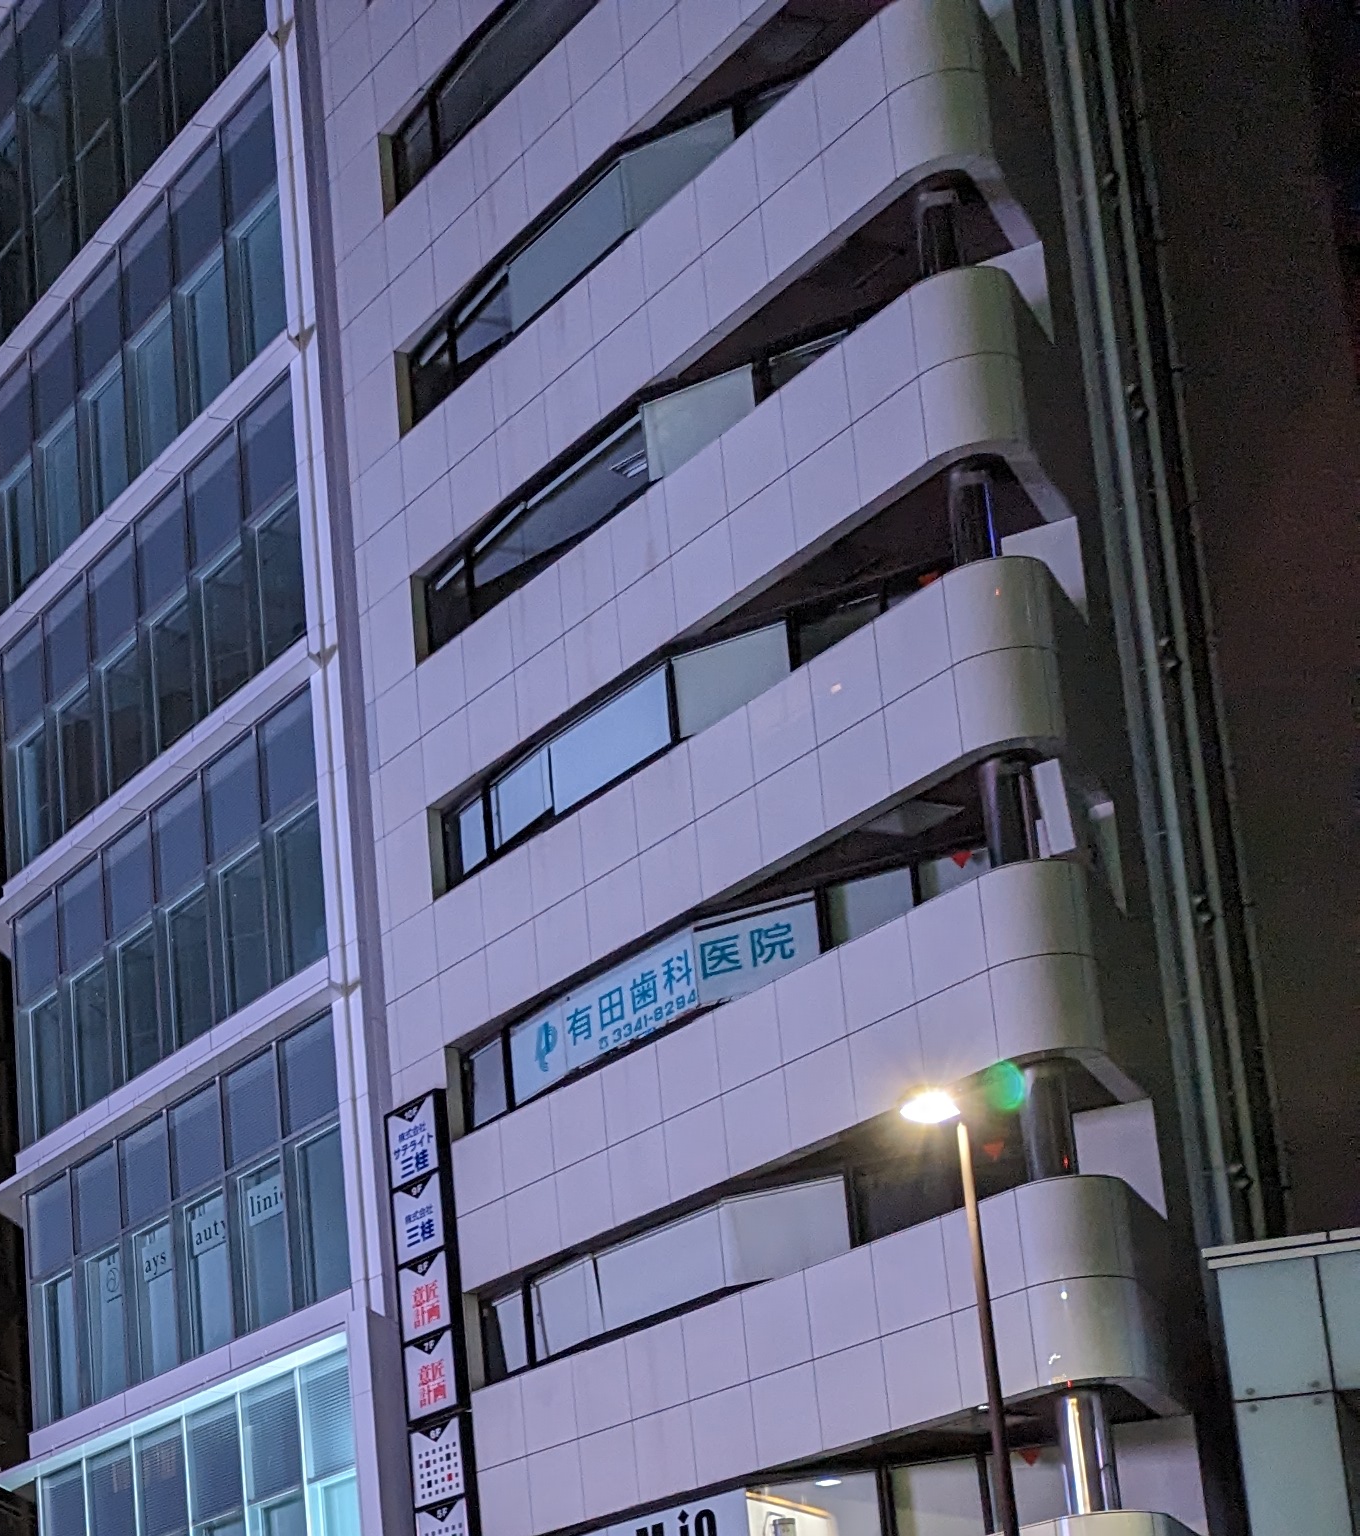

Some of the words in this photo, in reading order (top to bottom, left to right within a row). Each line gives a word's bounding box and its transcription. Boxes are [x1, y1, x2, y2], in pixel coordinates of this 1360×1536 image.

[566, 922, 795, 1046] 有田歯科医院
[393, 1132, 434, 1160] サテライト
